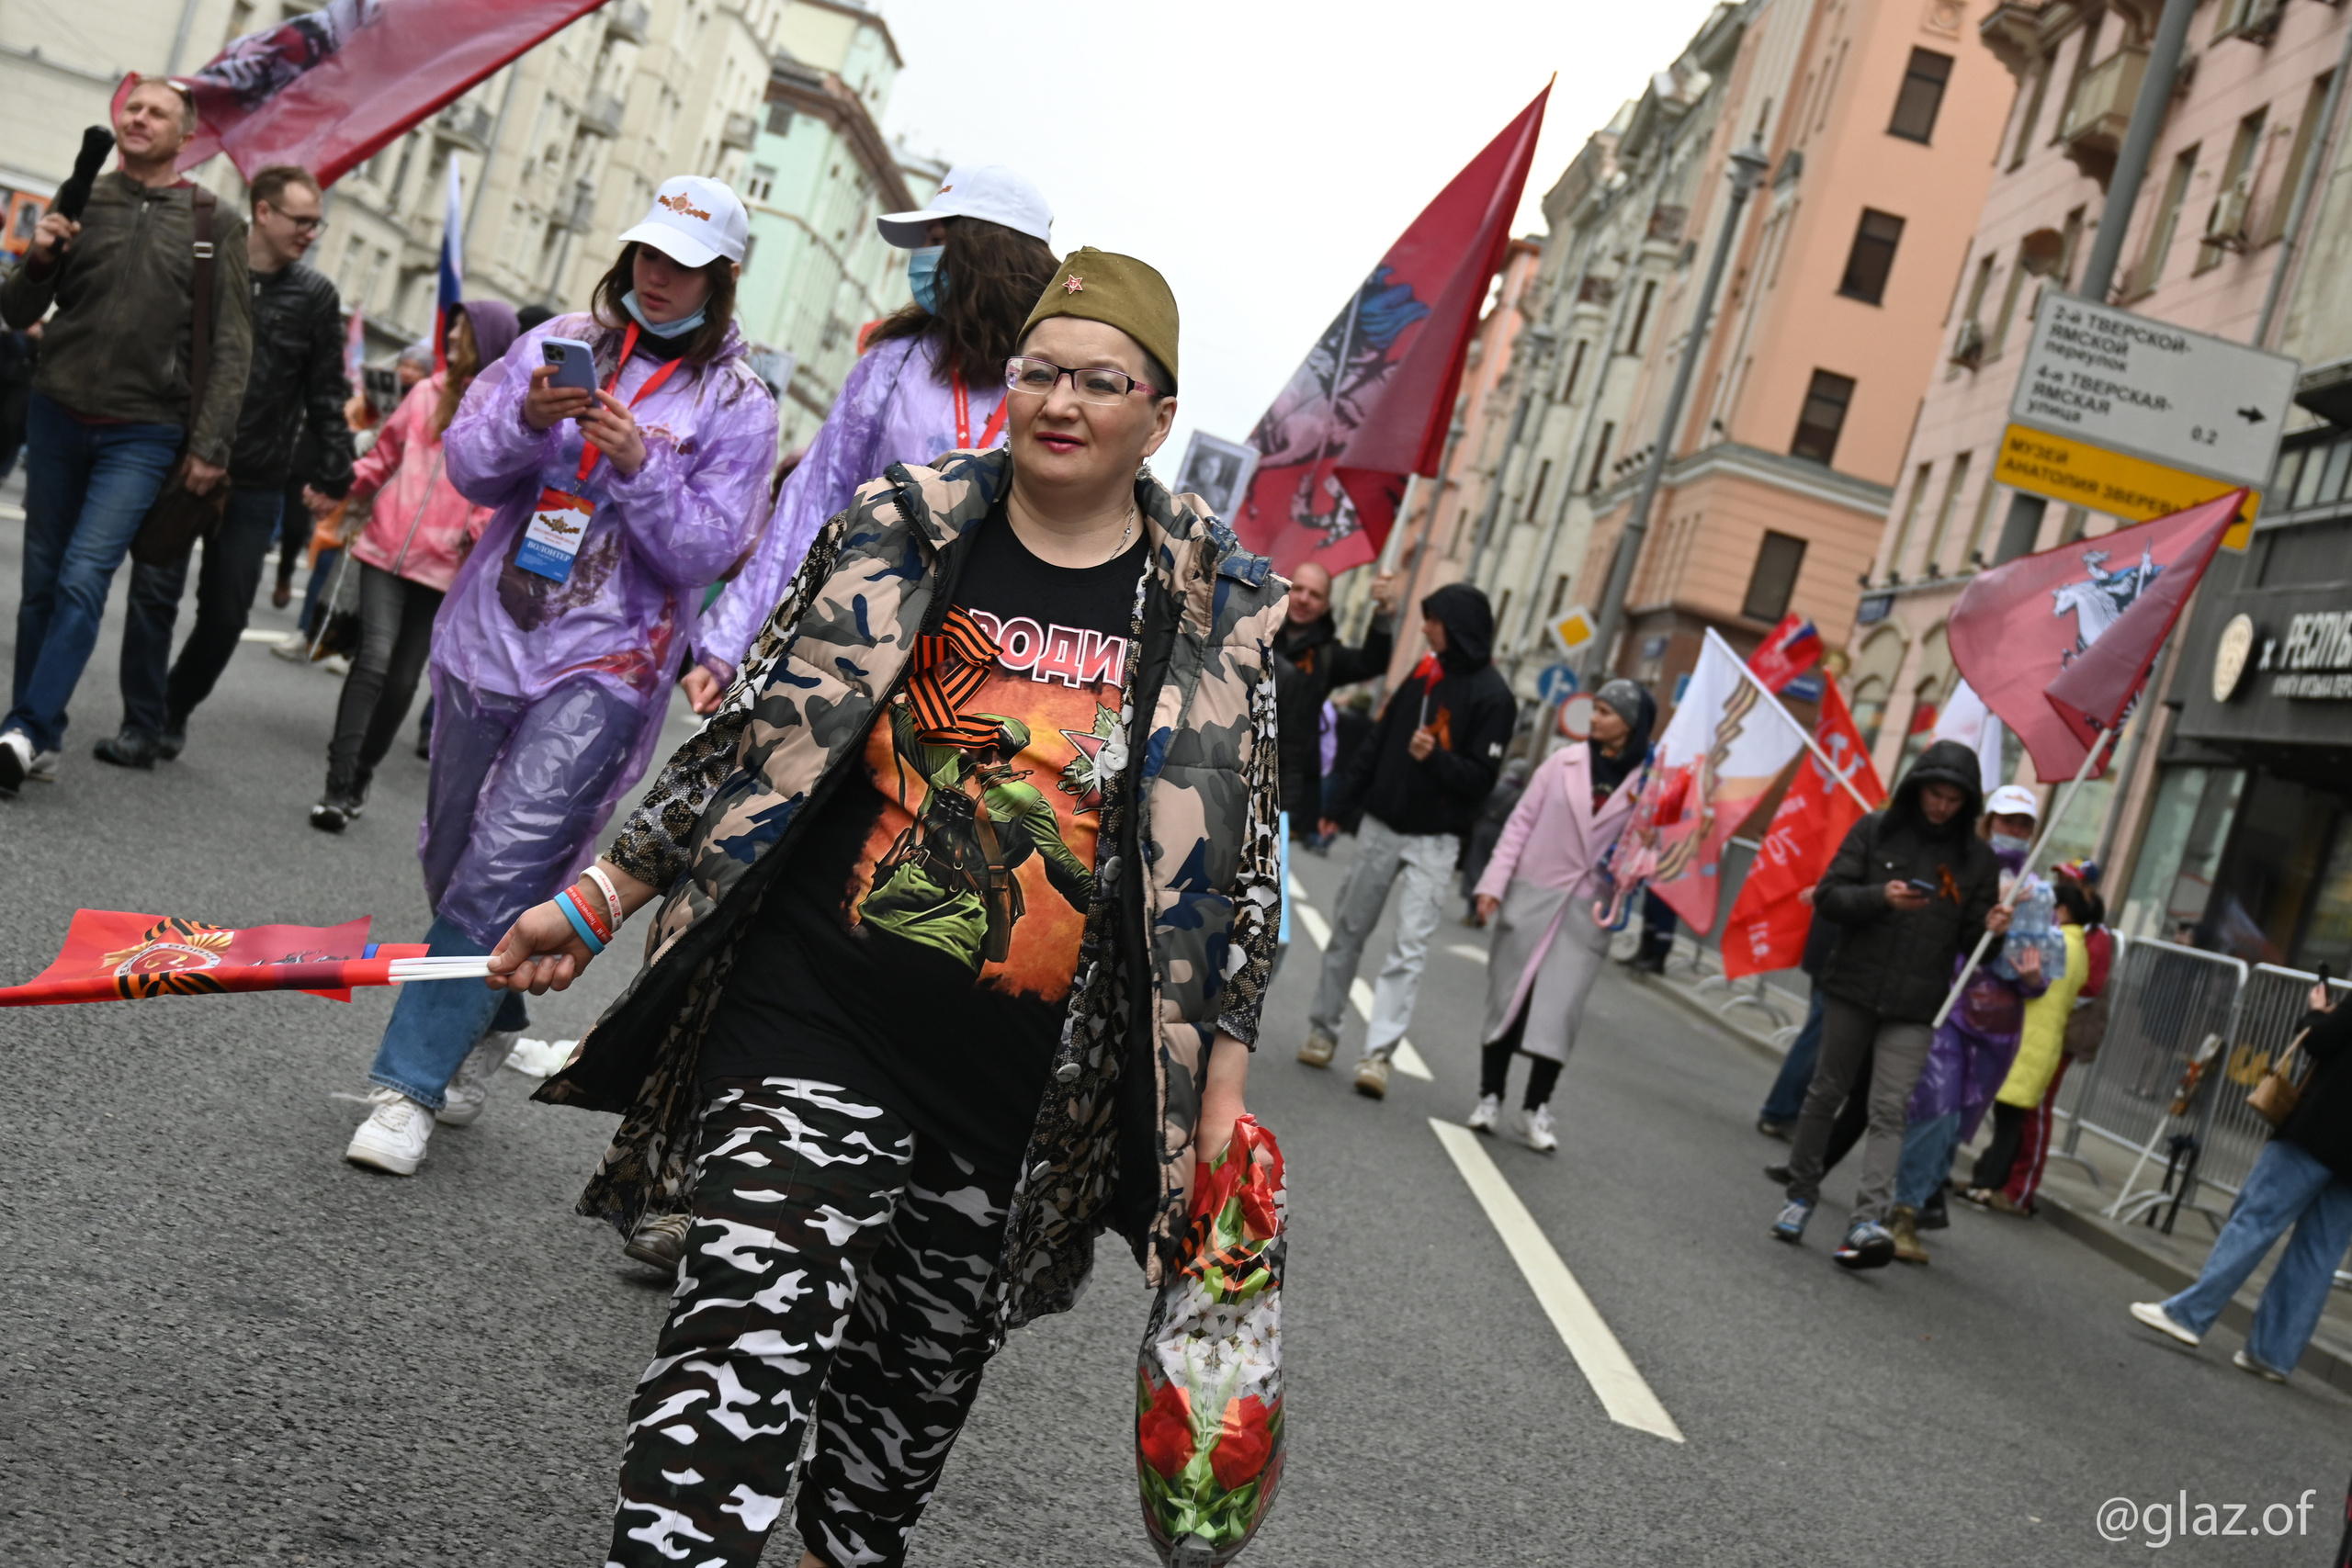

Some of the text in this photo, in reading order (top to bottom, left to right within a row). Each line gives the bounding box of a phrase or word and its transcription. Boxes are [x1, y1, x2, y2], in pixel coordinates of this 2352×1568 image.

[2049, 324, 2130, 356] ЯМСКОЙ
[2088, 314, 2192, 353] ТВЕРСКОЙ-
[2044, 341, 2128, 372] переулок
[2031, 383, 2111, 416] ЯМСКАЯ
[2070, 373, 2174, 412] ТВЕРСКАЯ-
[2026, 399, 2082, 425] улица
[2009, 436, 2069, 464] МУЗЕЙ
[2004, 459, 2099, 495] АНАТОЛИЯ
[526, 541, 571, 561] ВОЛОНТЕР
[968, 608, 1127, 689] РОДИ
